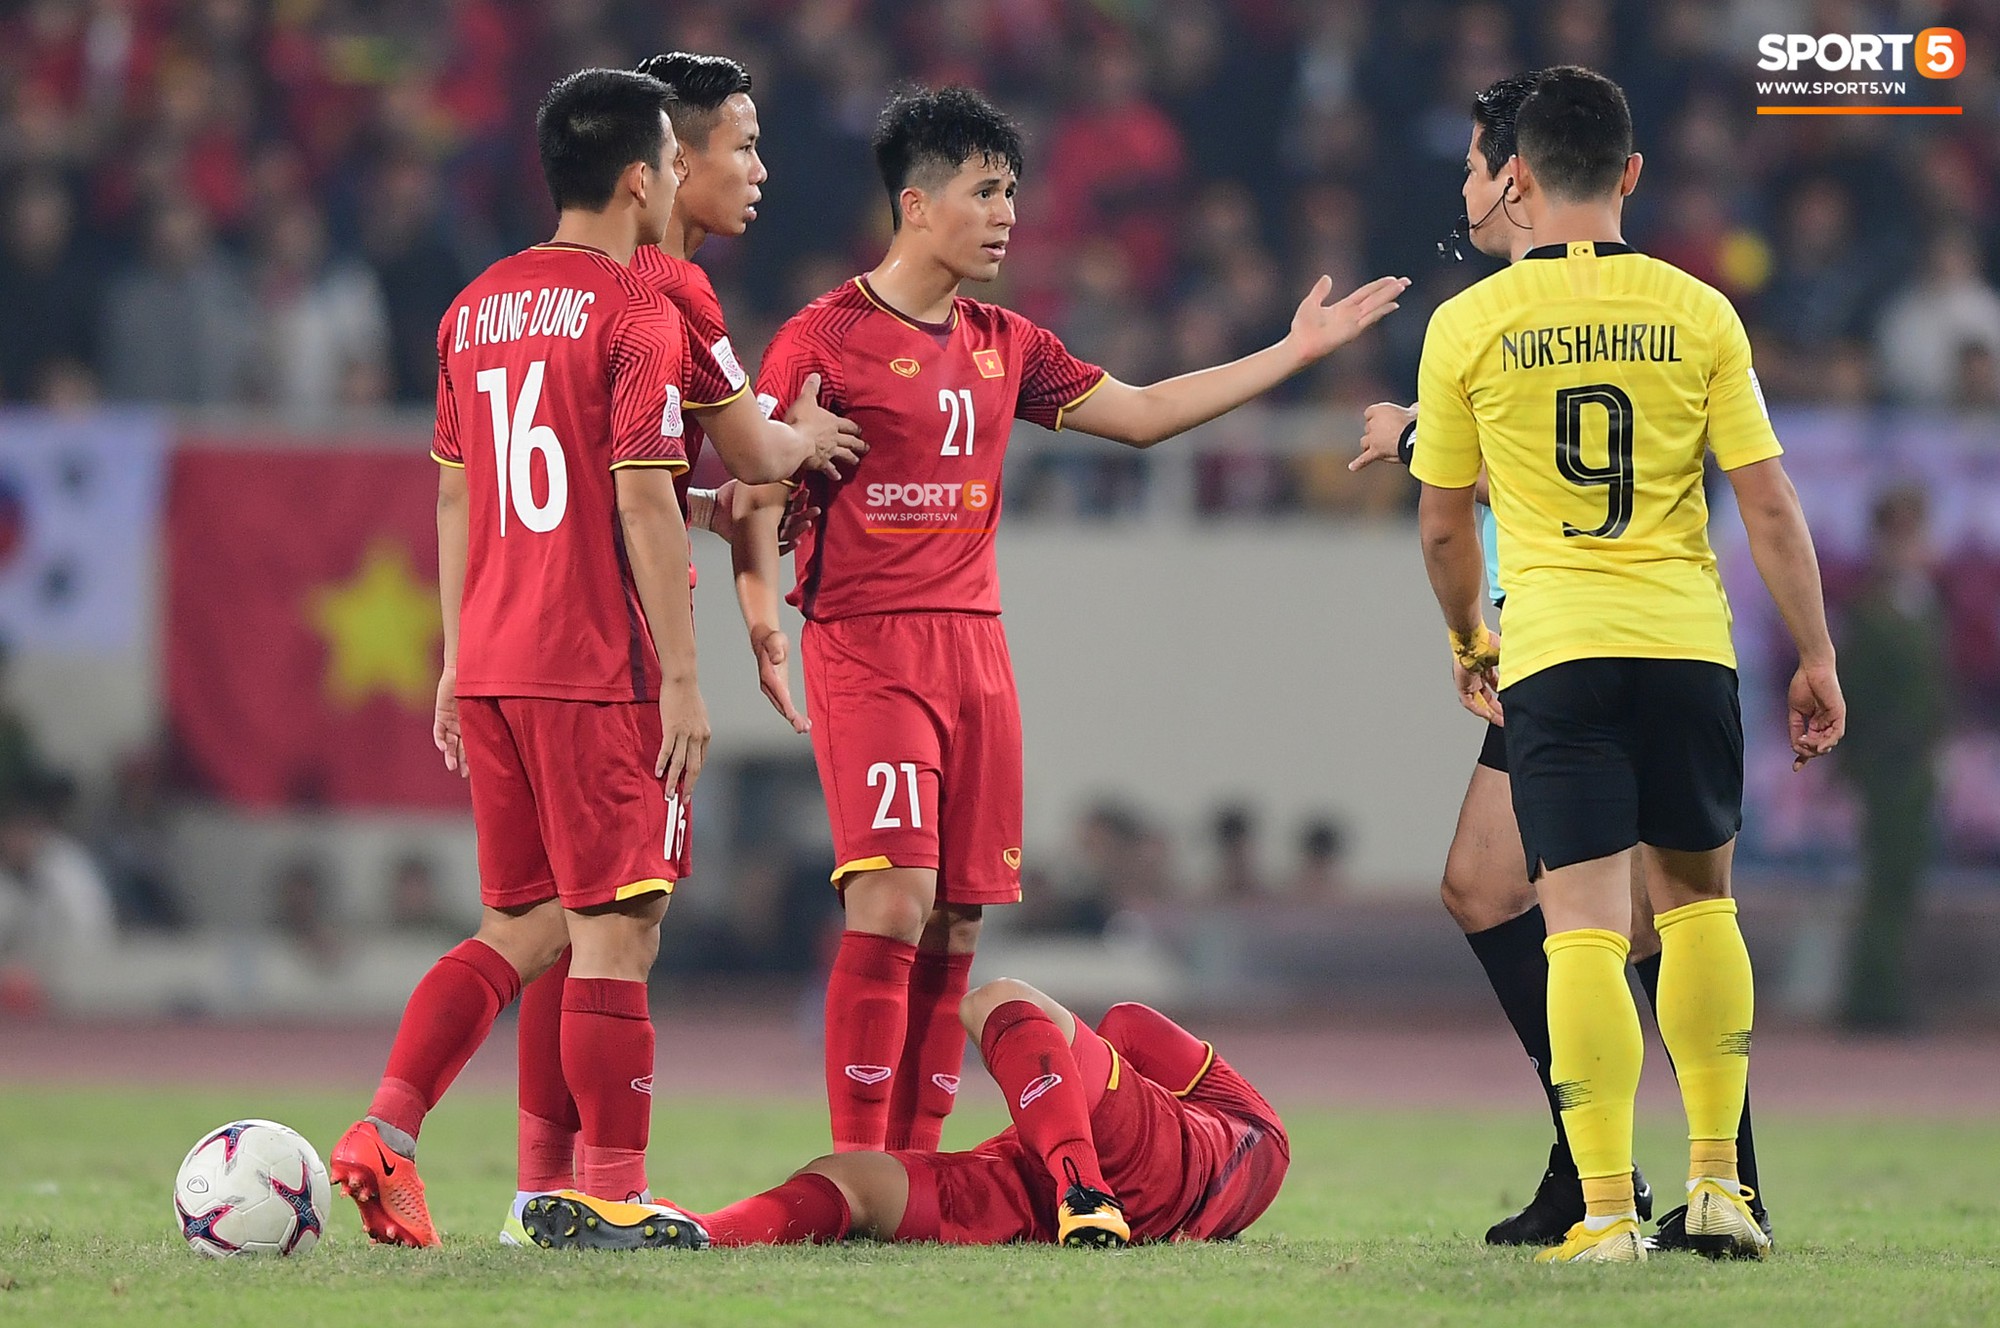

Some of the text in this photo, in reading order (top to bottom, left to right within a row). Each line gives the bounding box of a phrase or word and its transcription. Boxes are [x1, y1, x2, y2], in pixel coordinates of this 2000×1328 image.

[454, 287, 595, 354] D. HUNG DUNG
[1501, 323, 1682, 372] NORSHAHRUL
[476, 360, 569, 538] 16
[938, 388, 975, 456] 21
[1555, 383, 1634, 539] 9
[663, 792, 687, 861] 16
[866, 761, 922, 830] 21
